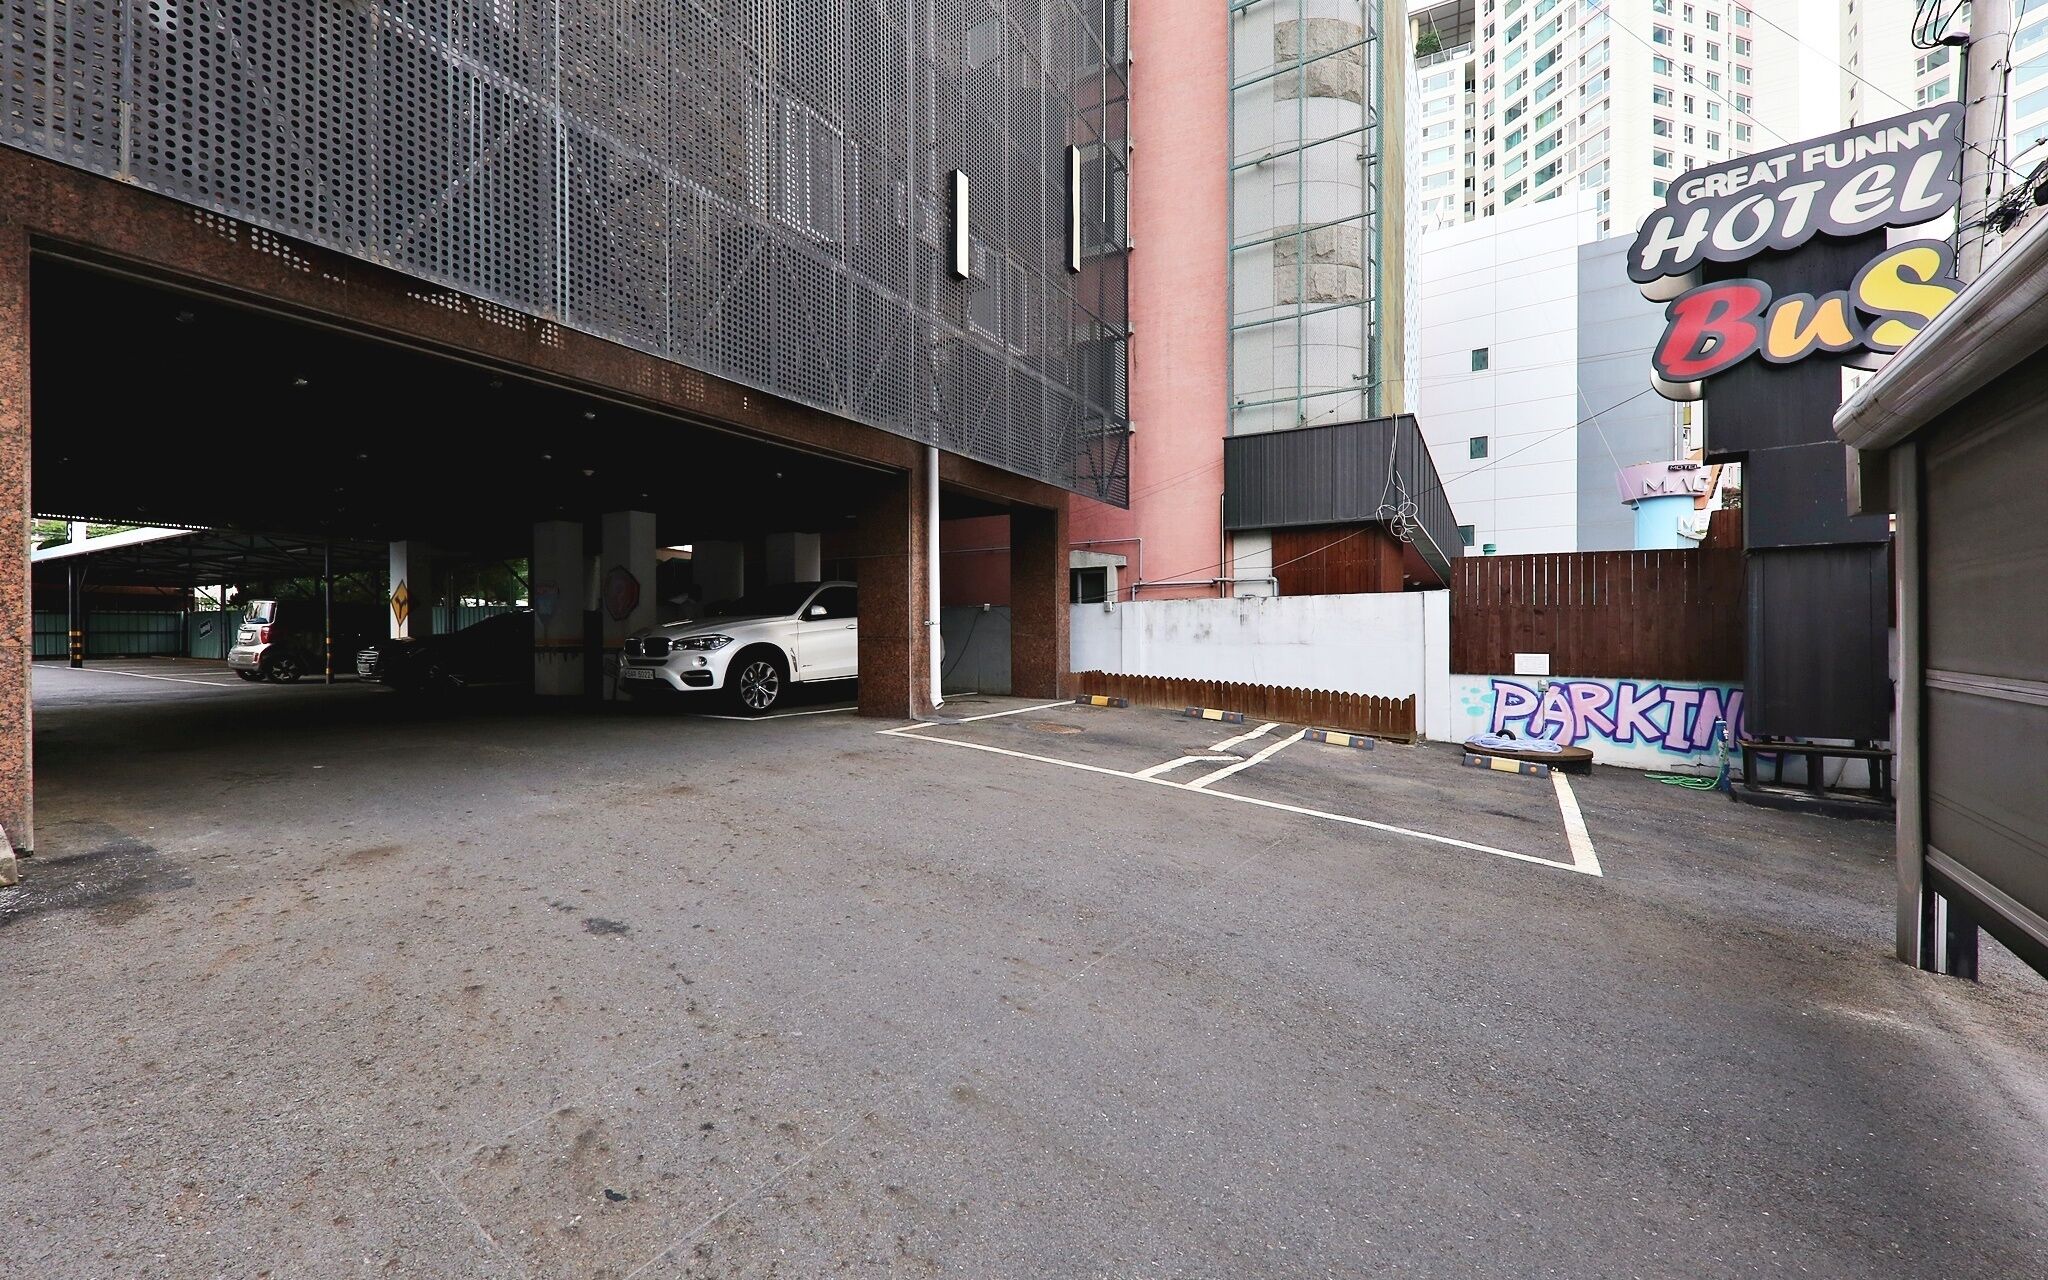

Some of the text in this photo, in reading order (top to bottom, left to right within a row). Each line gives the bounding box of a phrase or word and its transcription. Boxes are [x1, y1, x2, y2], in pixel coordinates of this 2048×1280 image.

[1677, 112, 1951, 206] GREAT FUNNY
[1491, 679, 1796, 759] PARKIN
